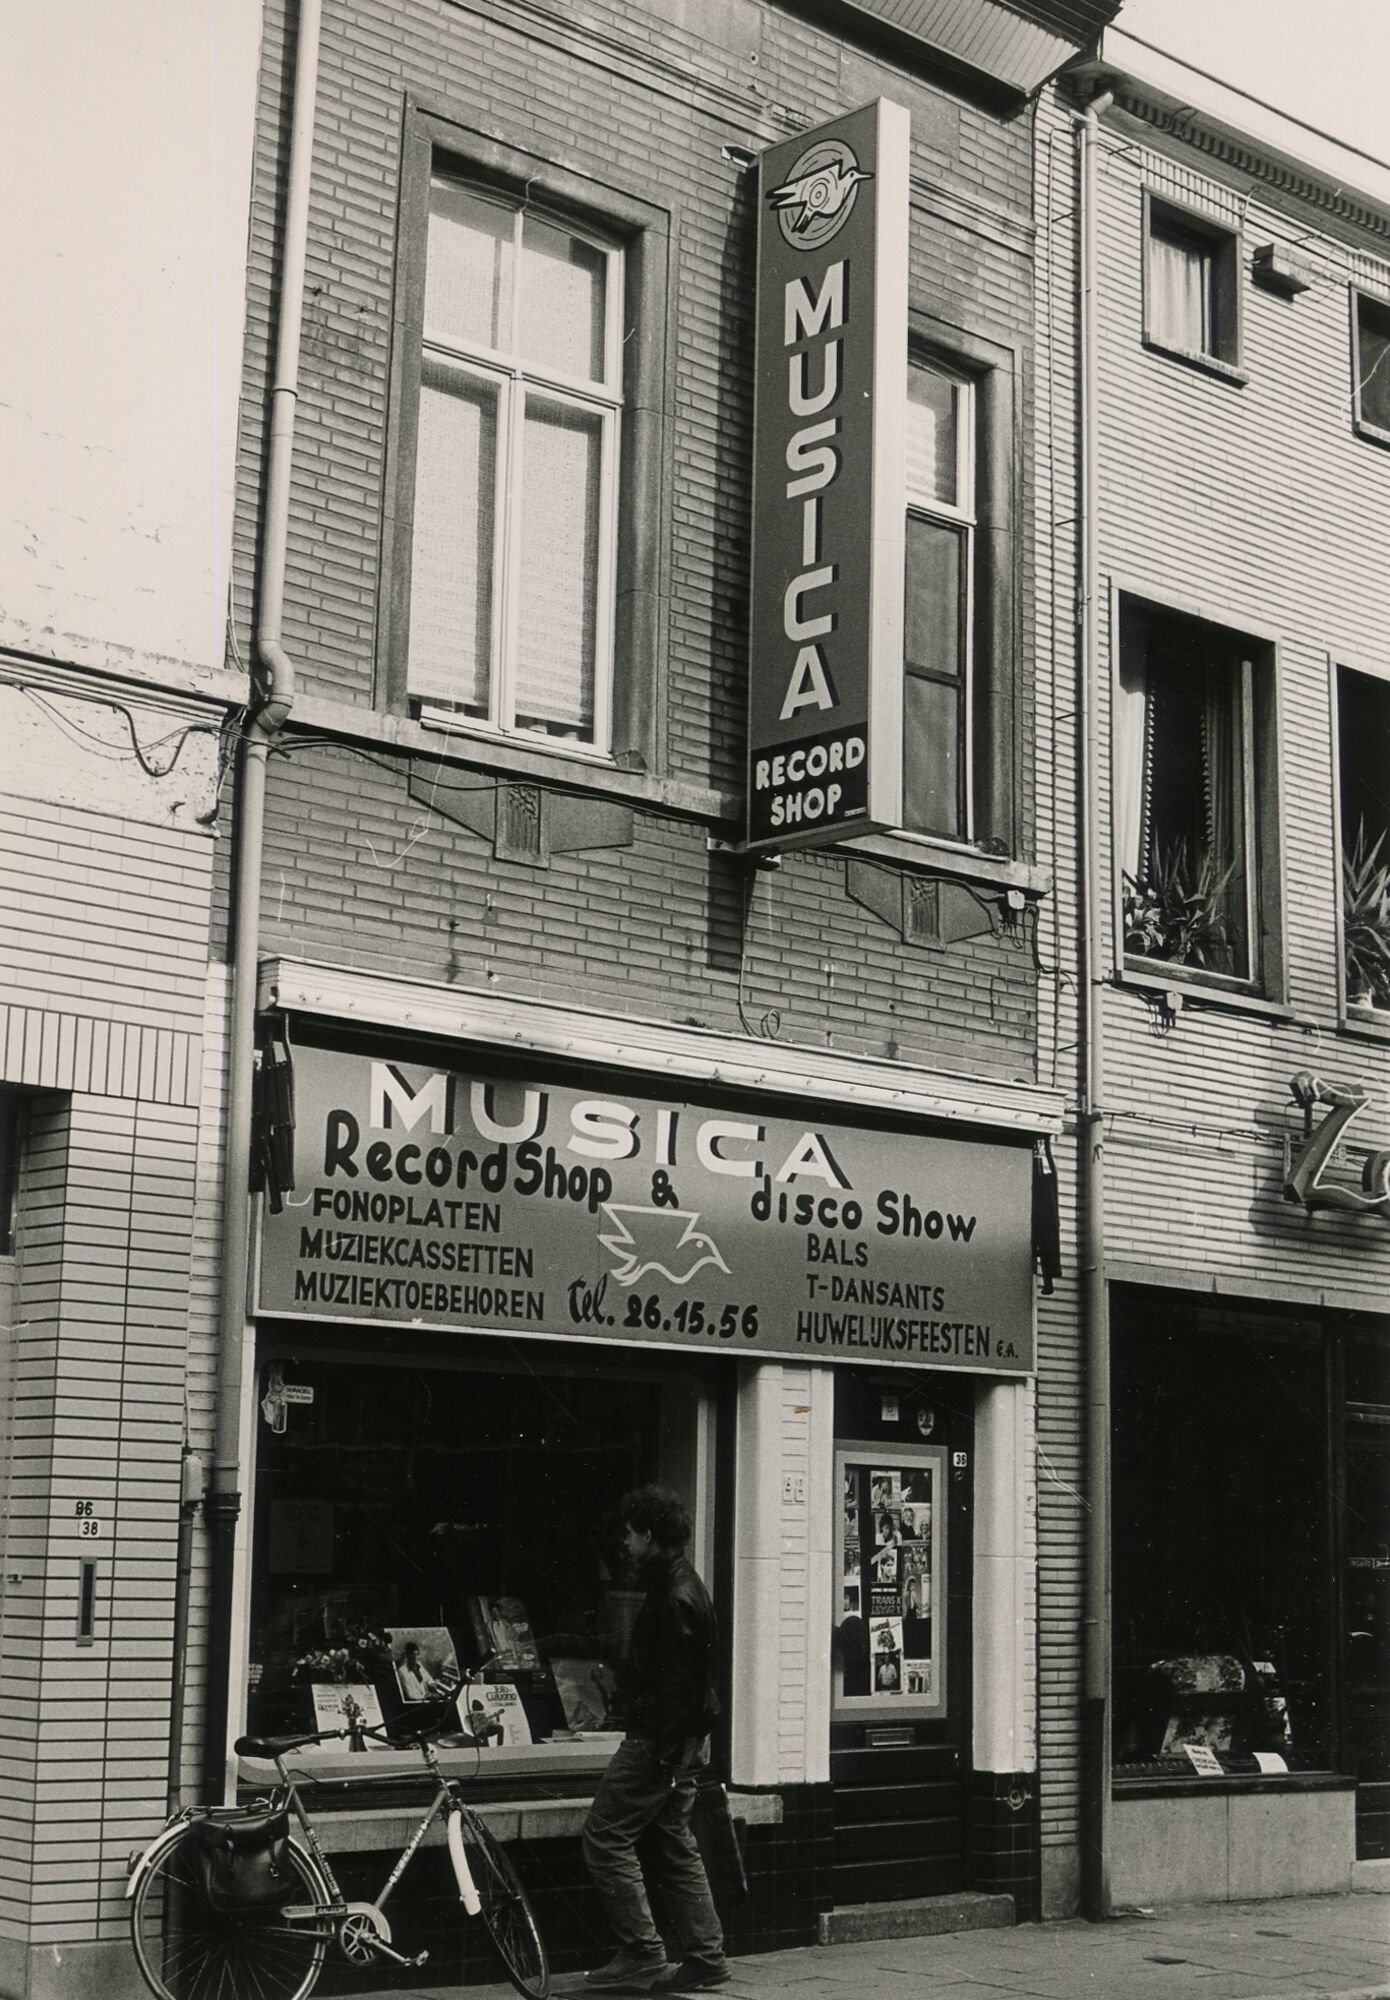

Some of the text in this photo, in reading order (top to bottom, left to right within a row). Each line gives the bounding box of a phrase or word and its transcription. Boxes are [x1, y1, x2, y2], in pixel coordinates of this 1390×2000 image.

[779, 259, 850, 721] MUSICA
[755, 737, 866, 790] RECORD
[770, 784, 842, 826] SHOP
[370, 1062, 853, 1190] MUSICA
[324, 1110, 976, 1242] Record Shop & disco Show
[313, 1187, 501, 1233] FONOPLATEN
[300, 1226, 533, 1278] MUZIEKCASSETTEN
[807, 1233, 868, 1267] BALS
[294, 1270, 544, 1321] MUZIEKTOEBEHOREN
[567, 1273, 759, 1339] Tel. 26.15.56
[807, 1273, 945, 1313] T-DANSANTS
[83, 1521, 98, 1536] 38
